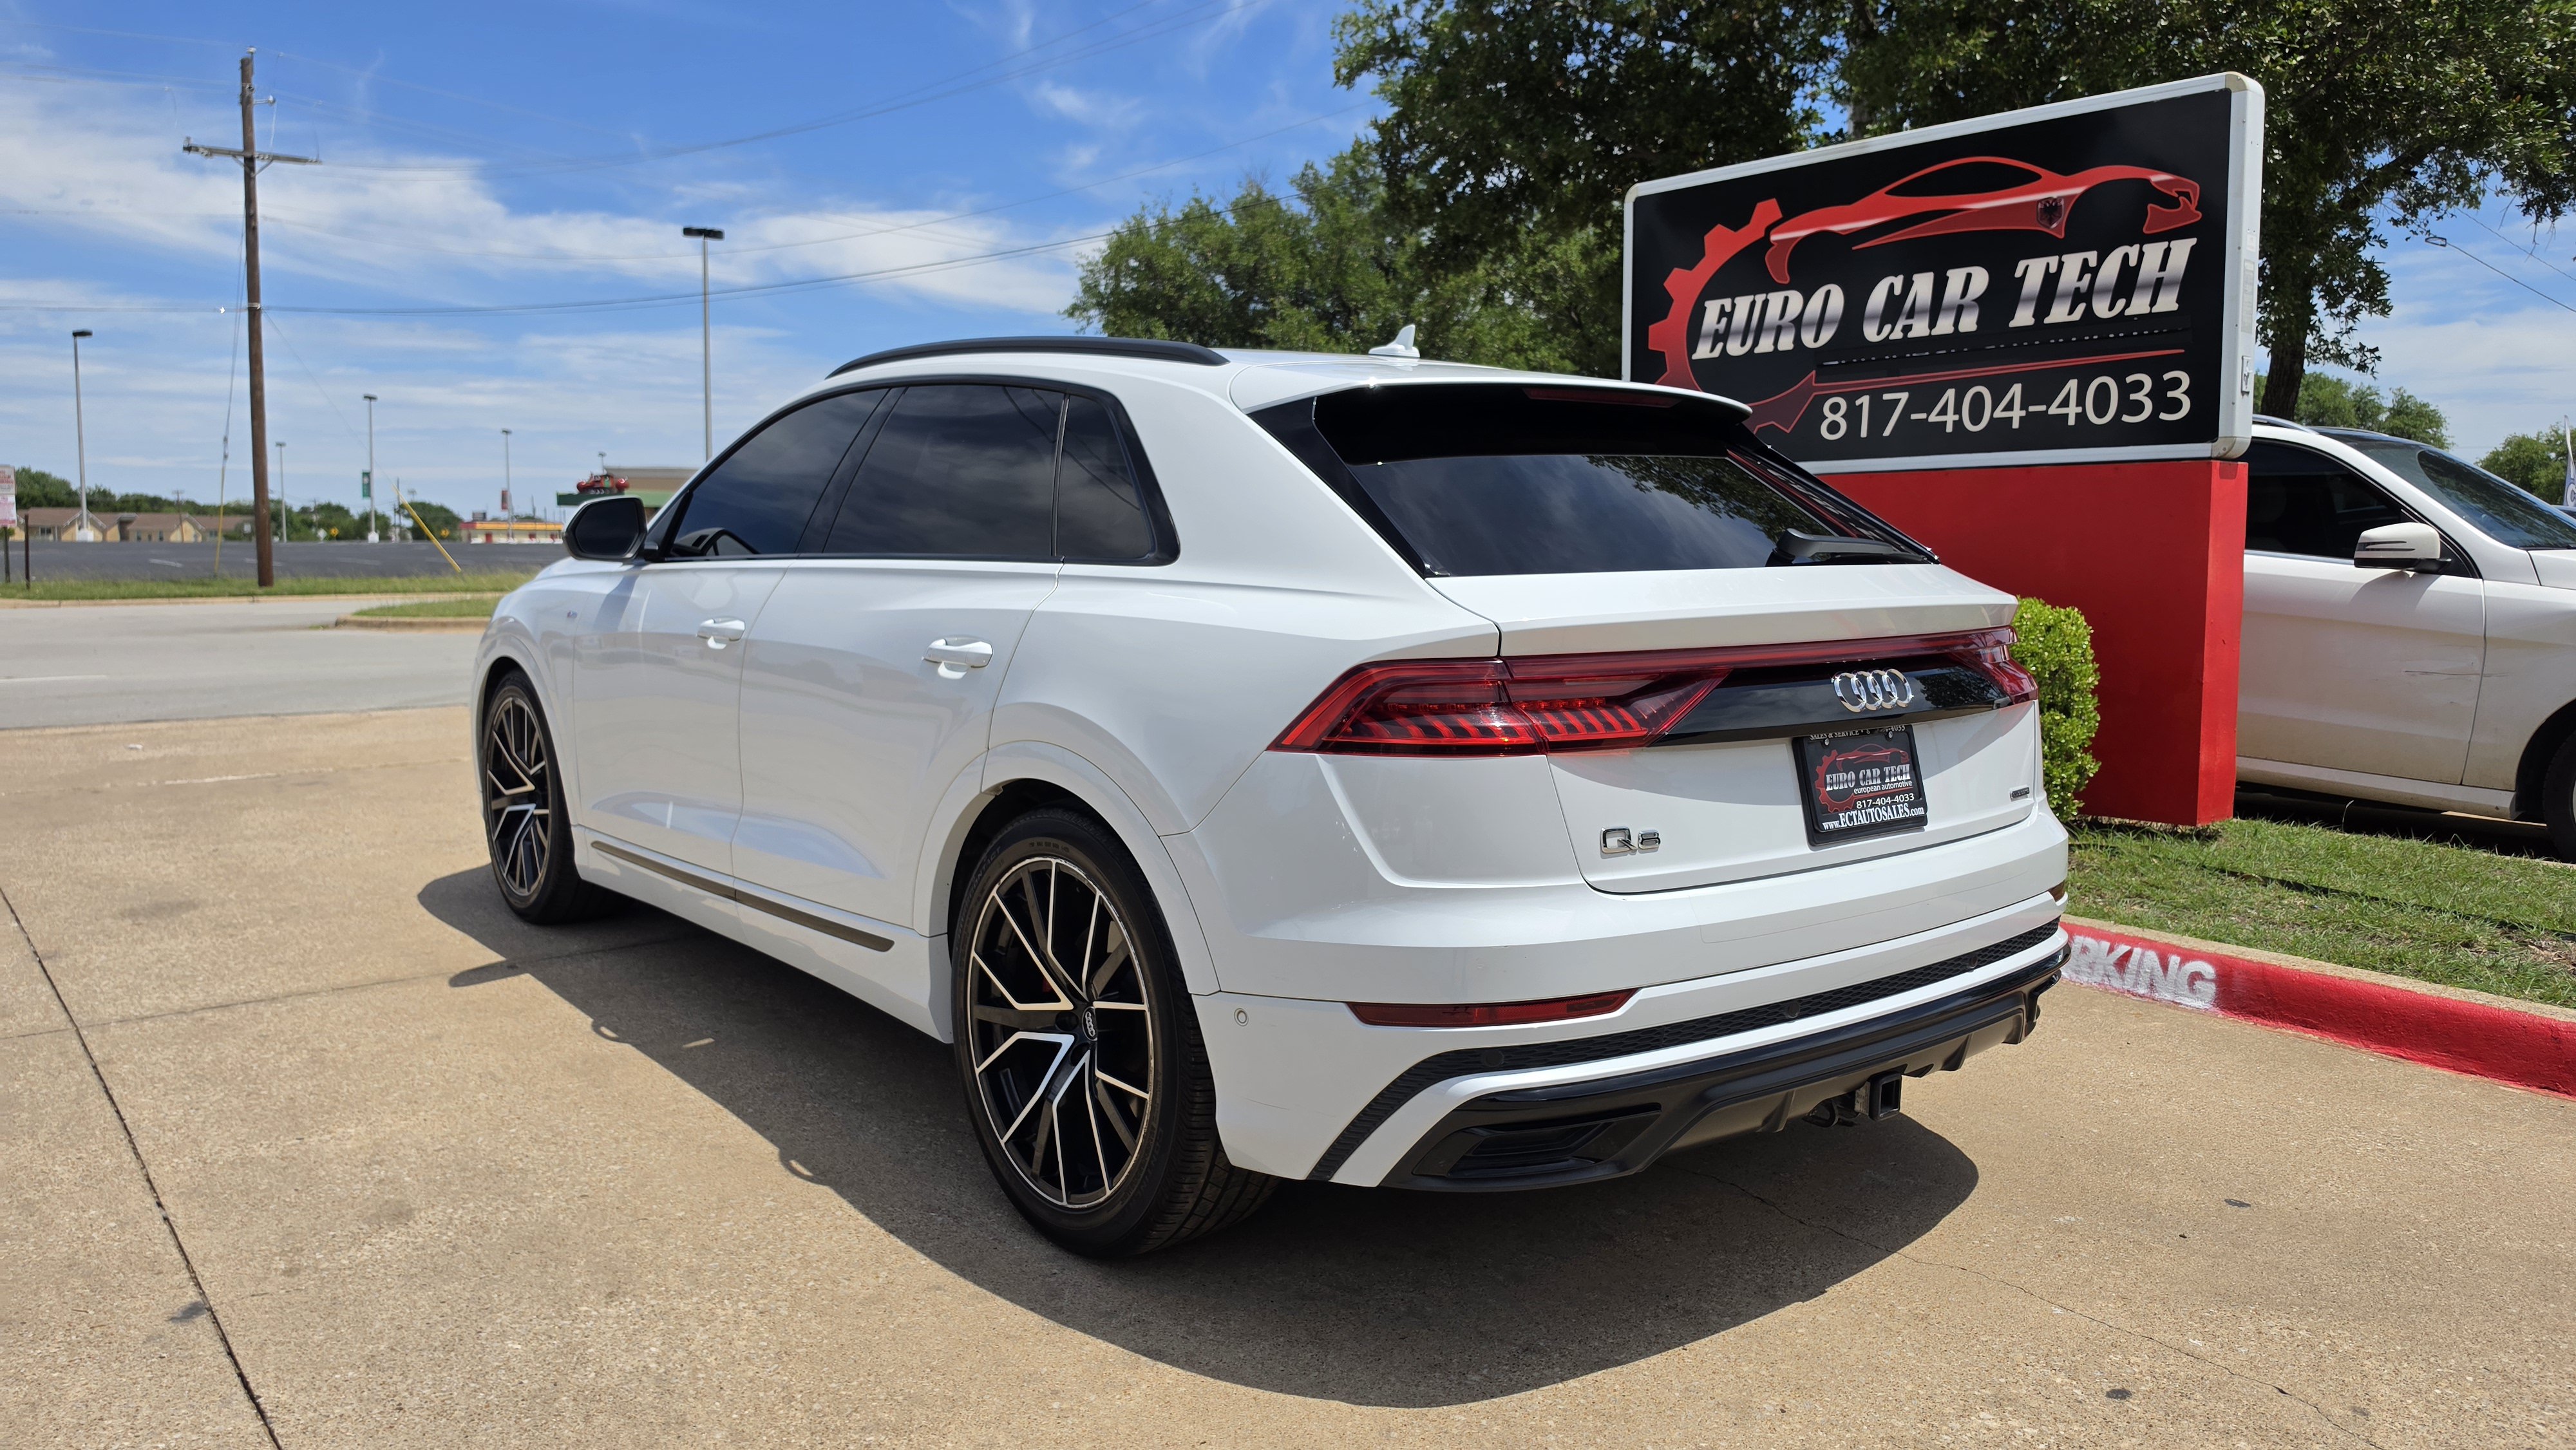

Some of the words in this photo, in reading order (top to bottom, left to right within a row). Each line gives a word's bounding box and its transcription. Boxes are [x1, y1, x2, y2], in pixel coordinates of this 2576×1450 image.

[1692, 284, 1844, 359] EURO
[1862, 265, 1989, 343] CAR
[2009, 238, 2197, 328] TECH
[1820, 370, 2192, 440] 817-404-4033
[1826, 771, 1855, 791] EURO
[1859, 768, 1881, 786] CAR
[1884, 764, 1911, 783] TECH
[1853, 784, 1881, 795] european
[1881, 780, 1913, 791] automotive
[1856, 793, 1915, 809] 817-404-4033
[1822, 802, 1925, 831] www.ECTAUTOSALES.com
[1600, 826, 1661, 854] Q8
[2061, 935, 2218, 1010] RKING
